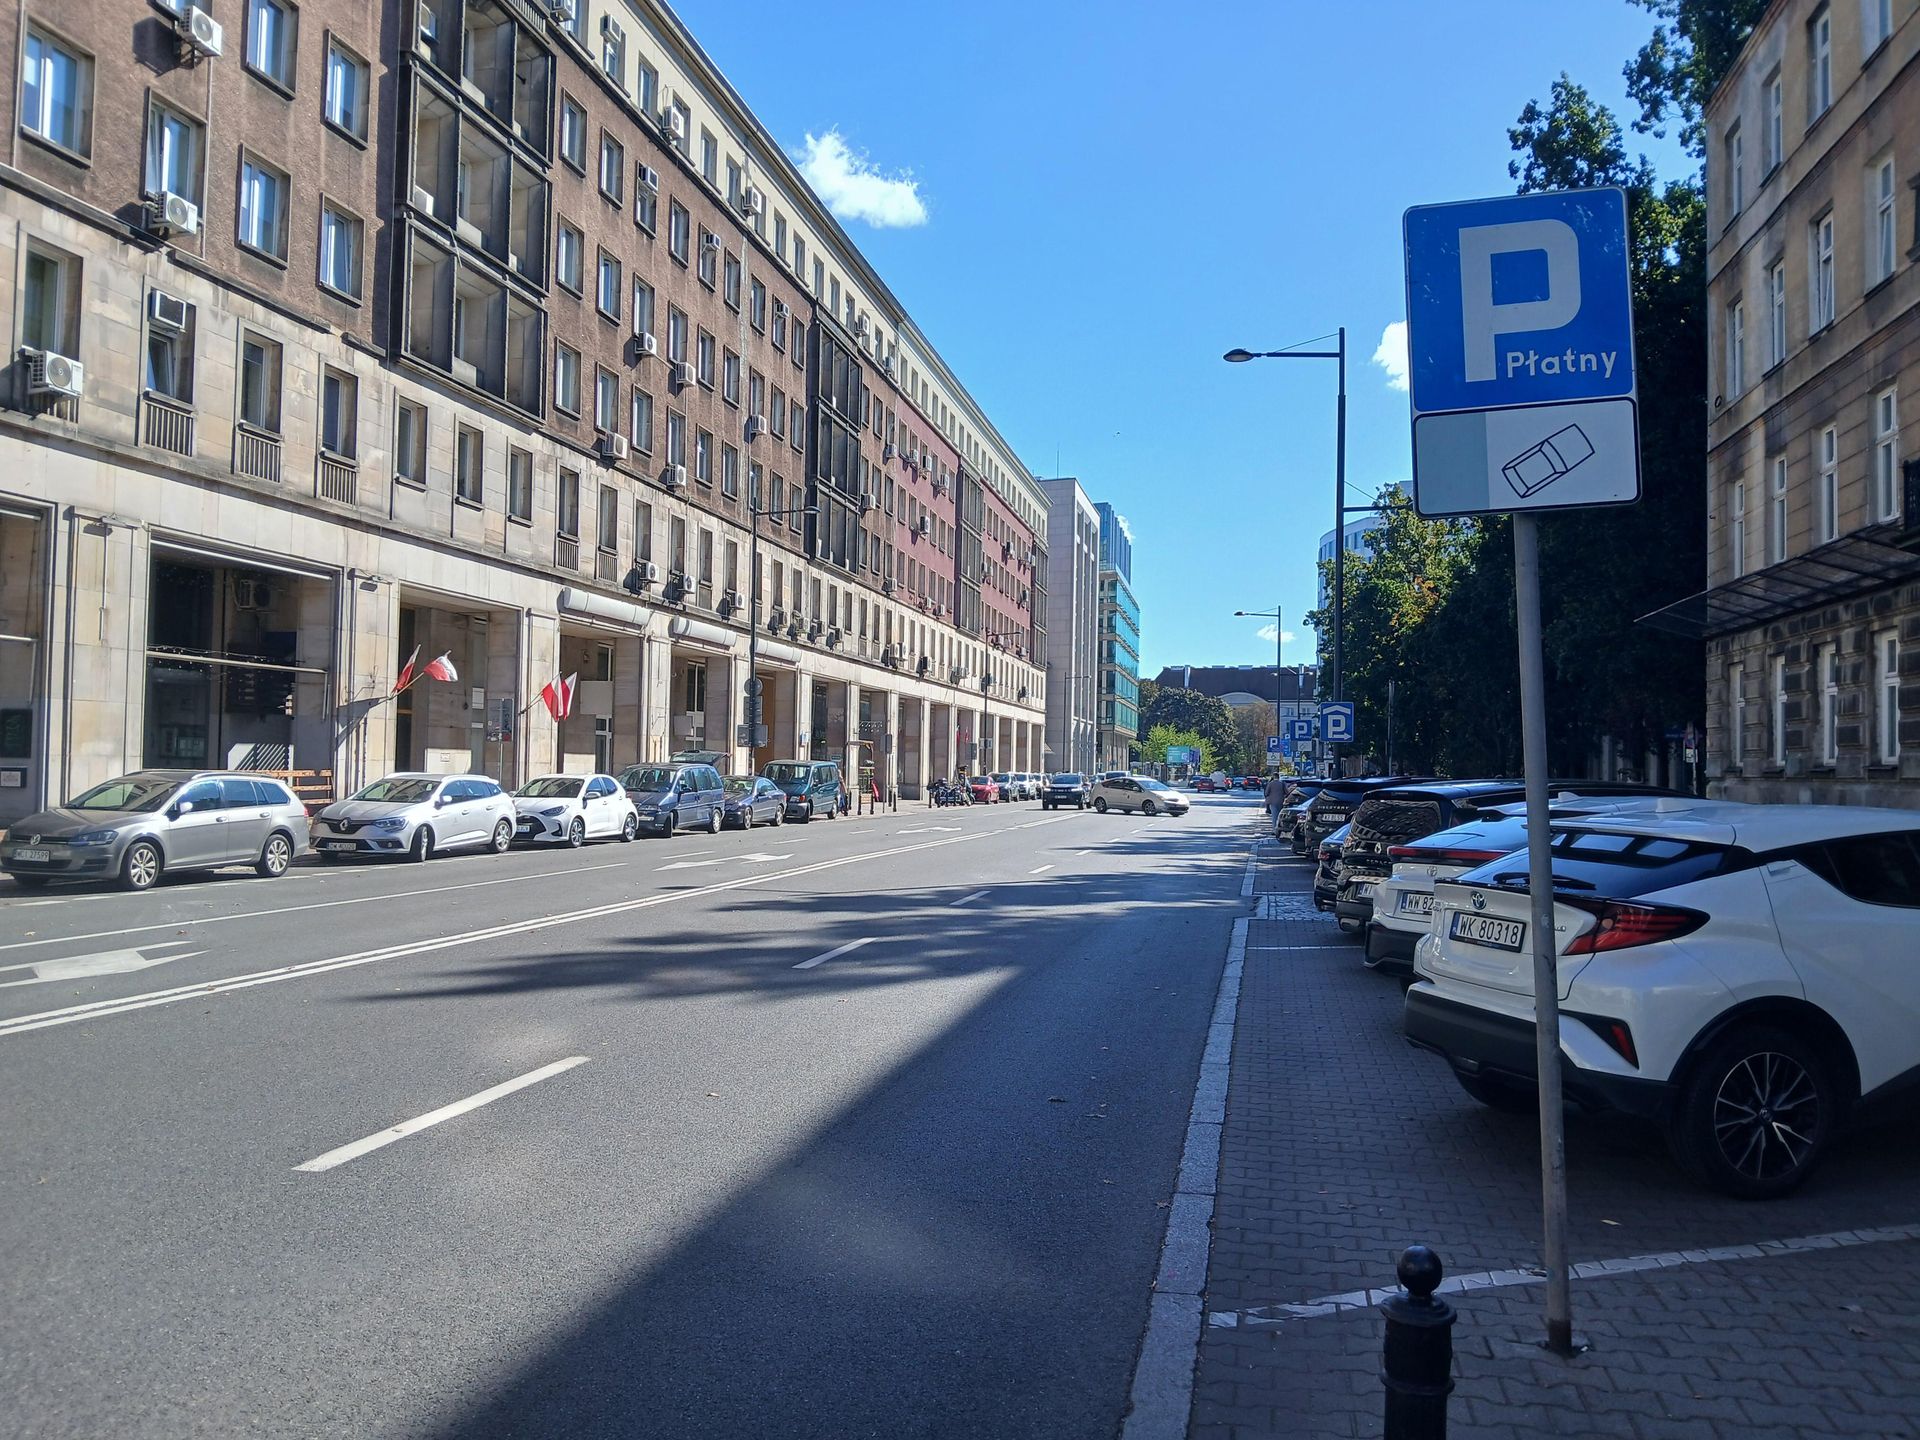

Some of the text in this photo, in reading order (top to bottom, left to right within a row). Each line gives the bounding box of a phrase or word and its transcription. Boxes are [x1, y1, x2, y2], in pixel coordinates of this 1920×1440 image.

[1458, 218, 1582, 383] P
[1506, 347, 1617, 379] Płatny
[1294, 721, 1308, 739] P
[1327, 714, 1346, 739] P
[1269, 737, 1278, 748] P
[1408, 894, 1421, 910] WW
[1422, 896, 1434, 911] 82
[1459, 915, 1520, 945] WK 80318
